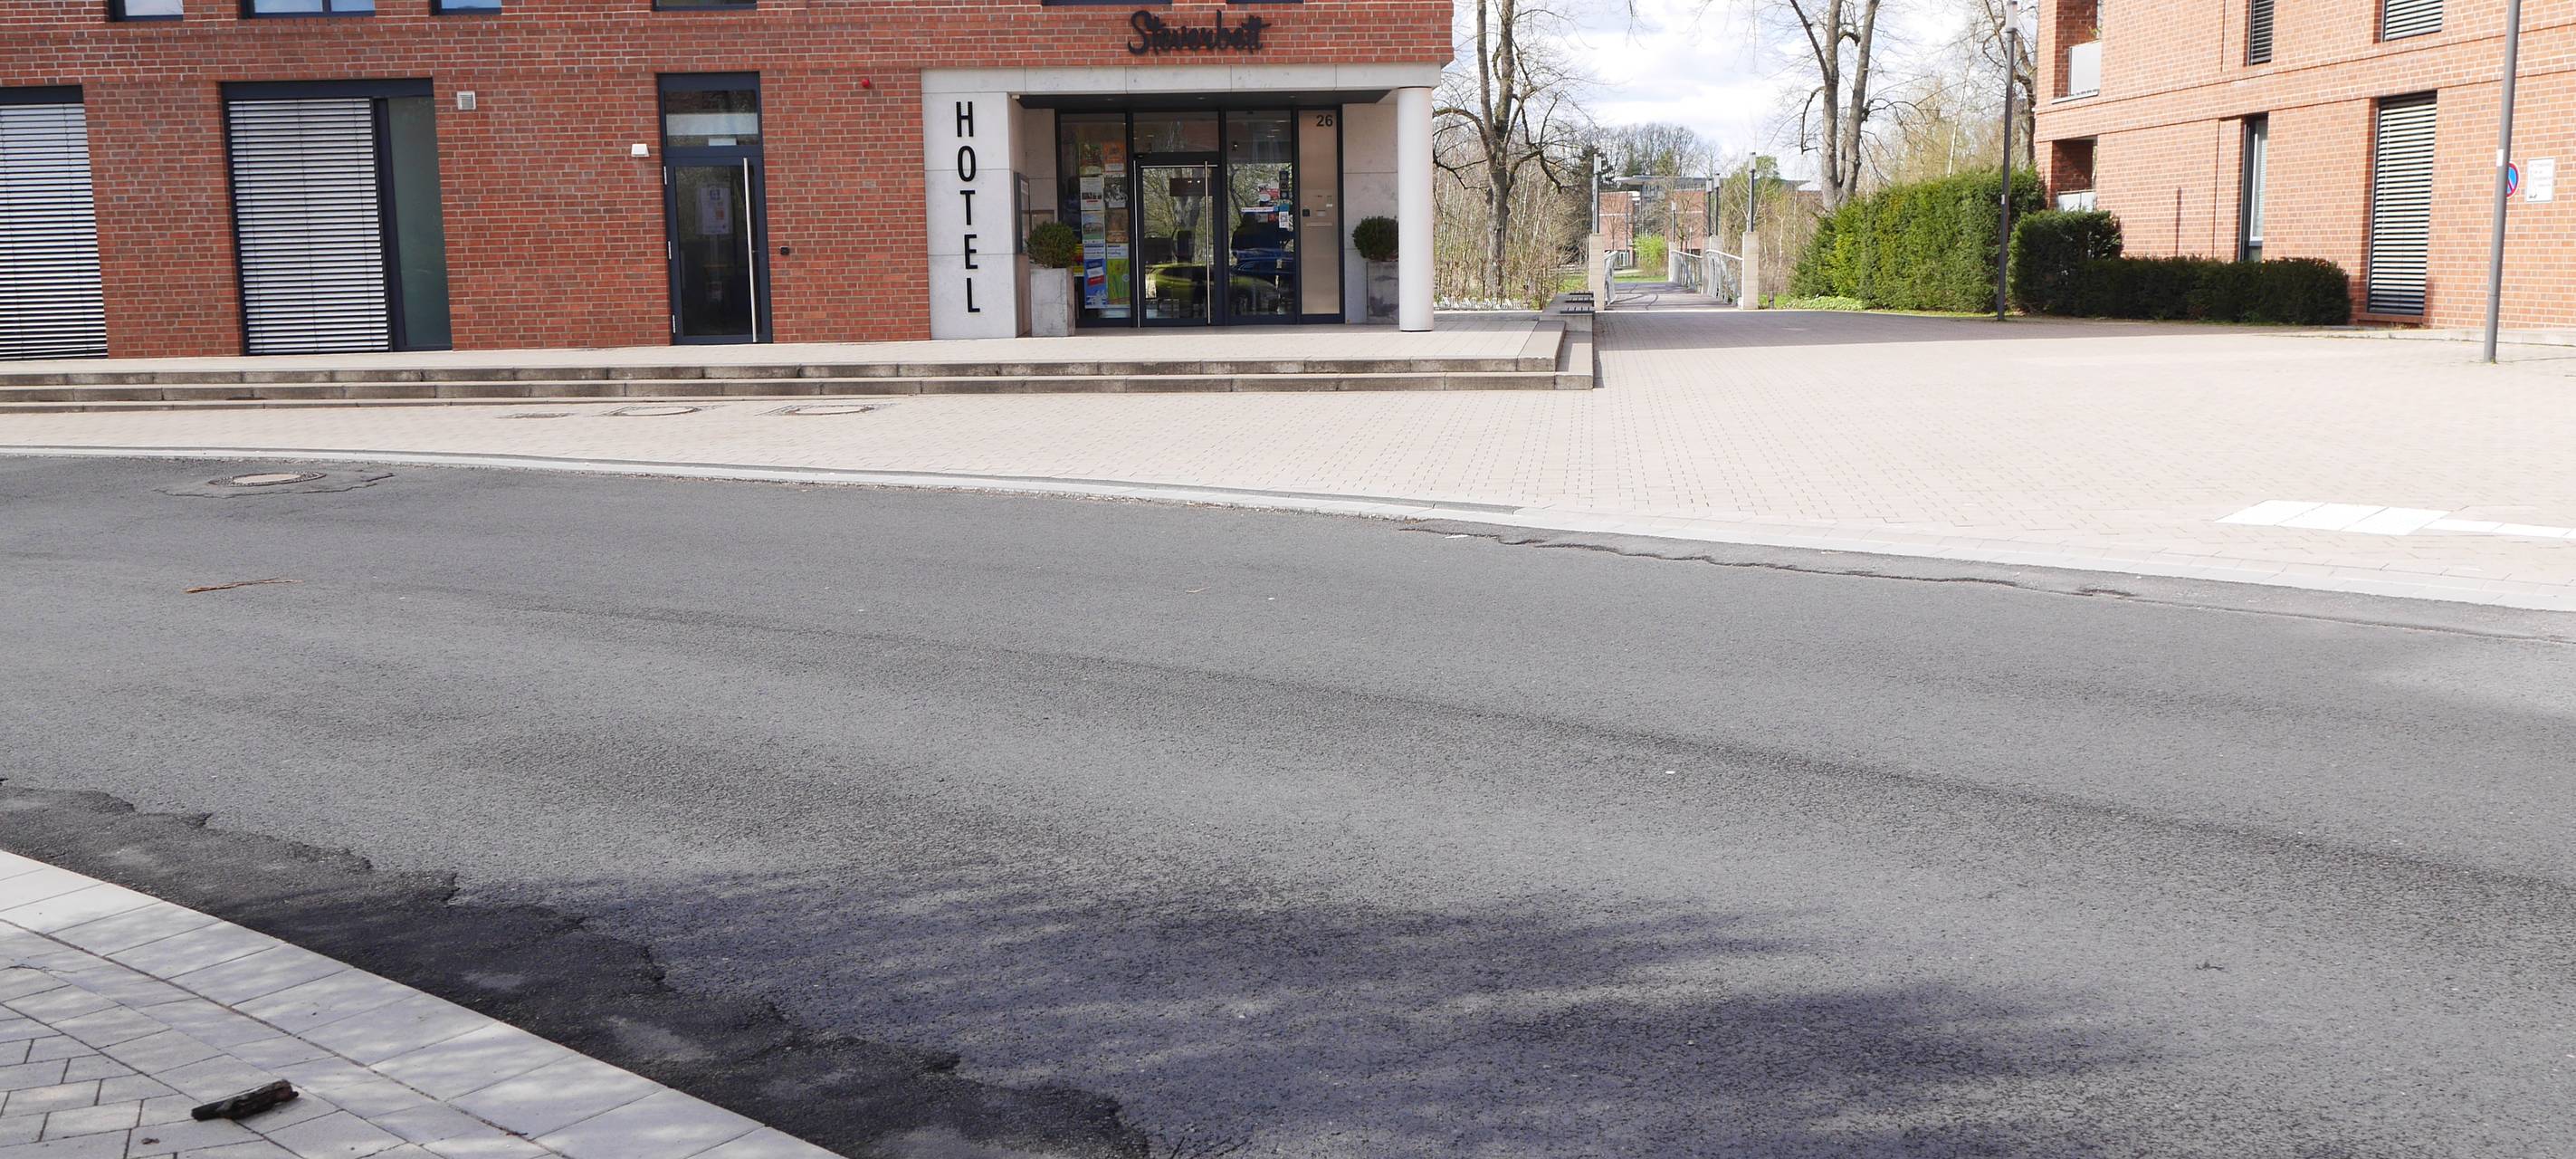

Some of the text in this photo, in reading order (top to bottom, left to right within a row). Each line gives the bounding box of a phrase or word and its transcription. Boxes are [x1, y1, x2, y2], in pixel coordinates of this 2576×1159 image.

[1128, 9, 1272, 55] Steverbett
[1316, 114, 1333, 127] 26
[956, 101, 980, 312] HOTEL
